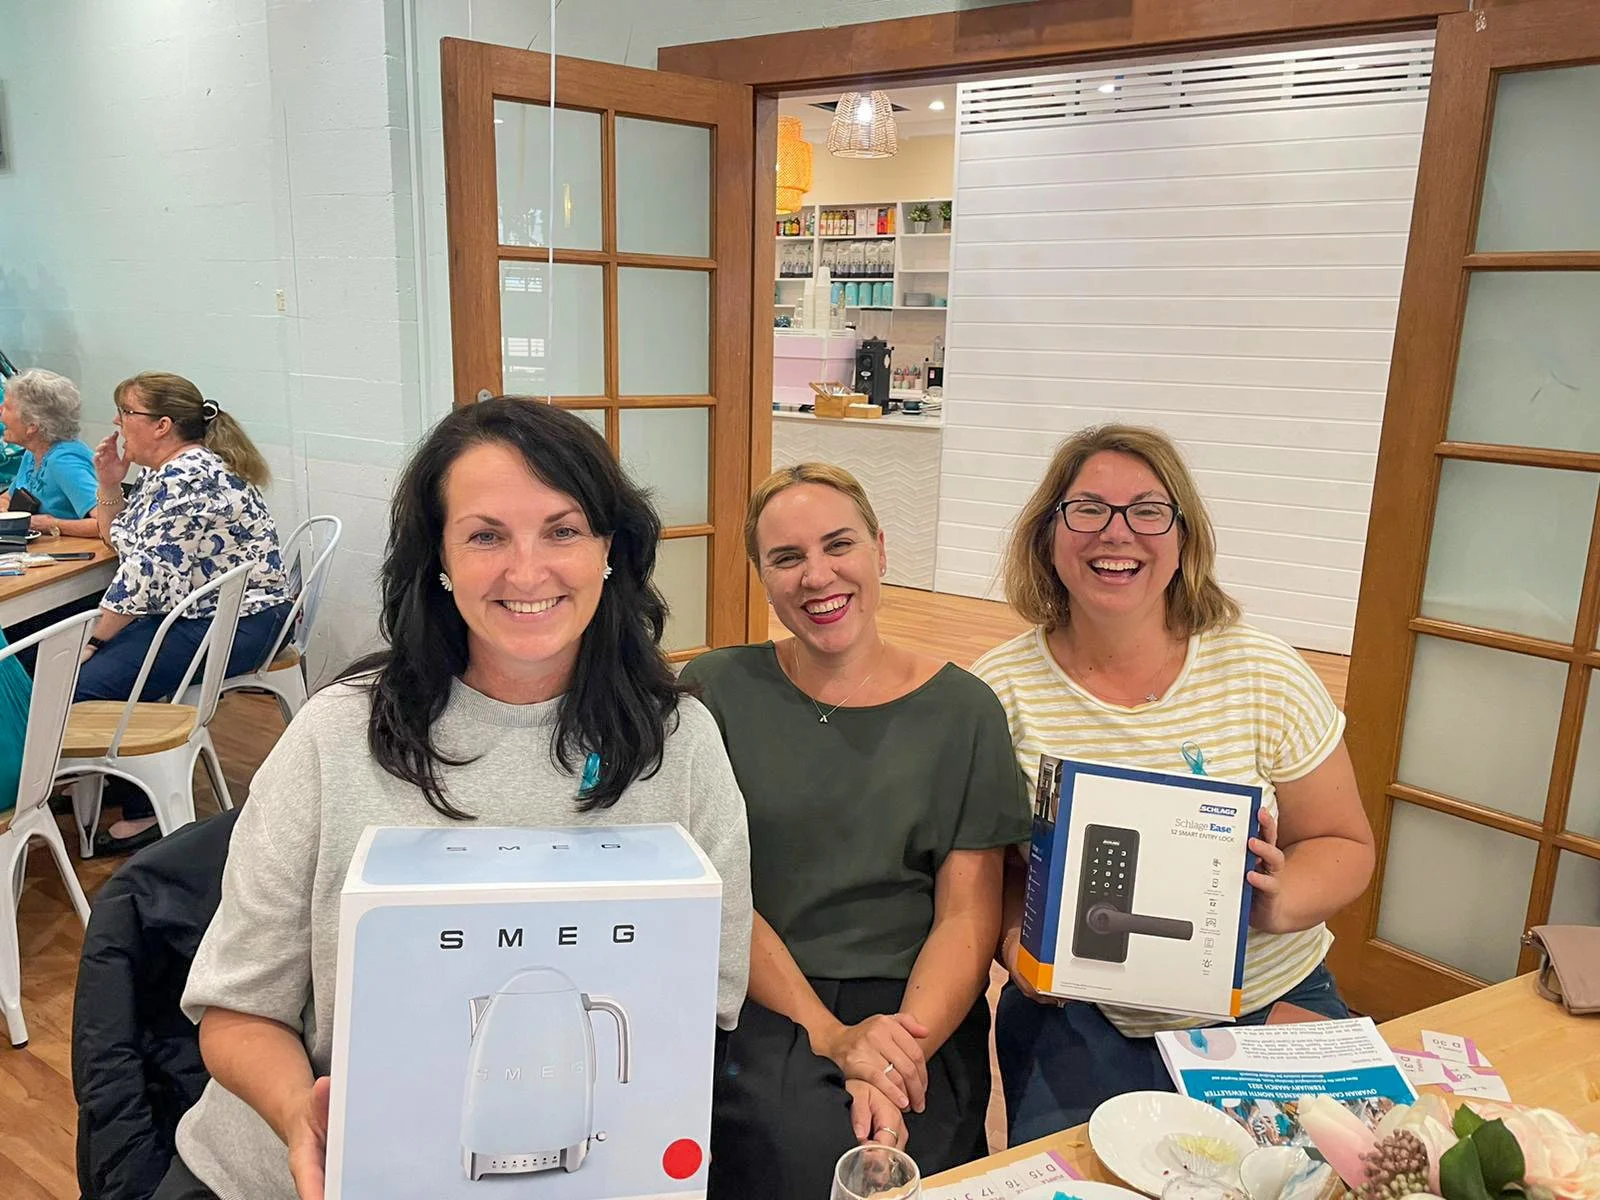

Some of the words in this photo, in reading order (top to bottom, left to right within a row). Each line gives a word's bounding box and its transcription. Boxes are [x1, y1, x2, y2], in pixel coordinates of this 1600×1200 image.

[1199, 804, 1236, 816] SCHLAGE
[1175, 818, 1209, 831] Schlage
[1210, 823, 1232, 833] Ease
[1179, 830, 1198, 838] SMART
[440, 924, 635, 949] SMEG
[475, 1061, 584, 1081] SMEG
[1203, 1089, 1248, 1097] NEWSLETTER
[1248, 1090, 1275, 1098] MONTH
[1345, 1088, 1378, 1098] OVARIAN
[1045, 1163, 1056, 1172] D
[1028, 1168, 1043, 1179] 15
[1005, 1178, 1020, 1189] 16
[981, 1187, 994, 1197] 17
